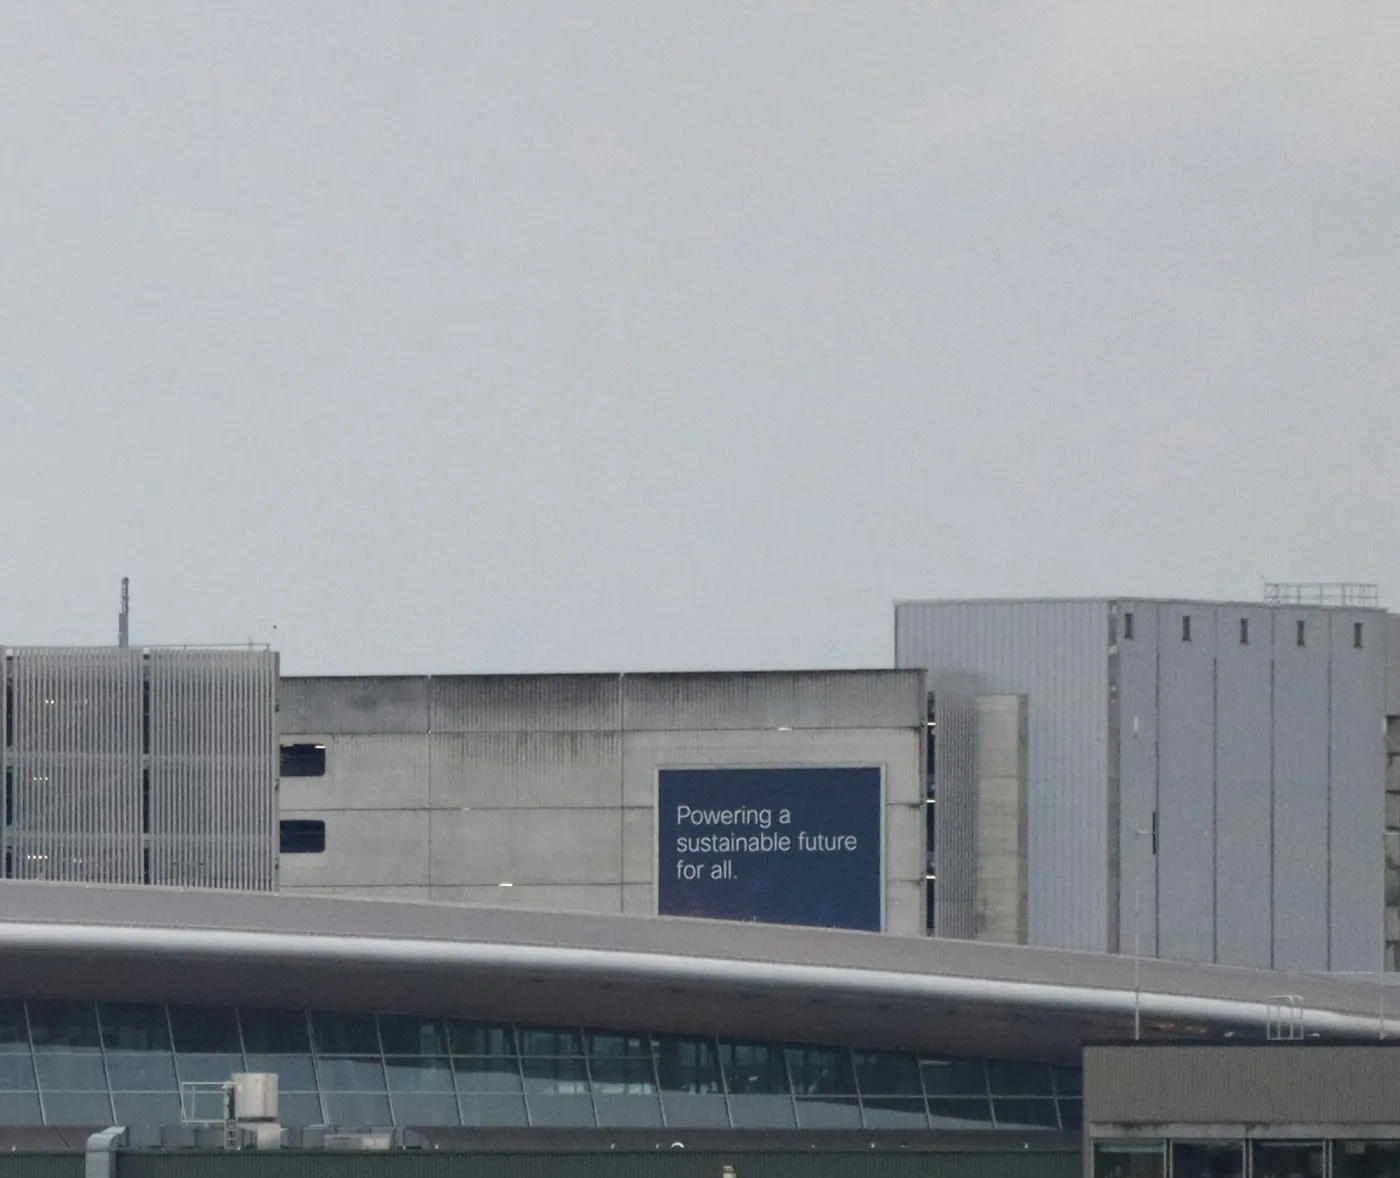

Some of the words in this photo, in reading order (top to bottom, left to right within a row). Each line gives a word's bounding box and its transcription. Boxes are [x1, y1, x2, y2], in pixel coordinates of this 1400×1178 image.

[677, 805, 771, 829] Powering
[779, 808, 791, 824] a
[677, 832, 791, 852] sustainable
[798, 831, 857, 851] future
[677, 860, 704, 879] for
[710, 860, 737, 880] all.
